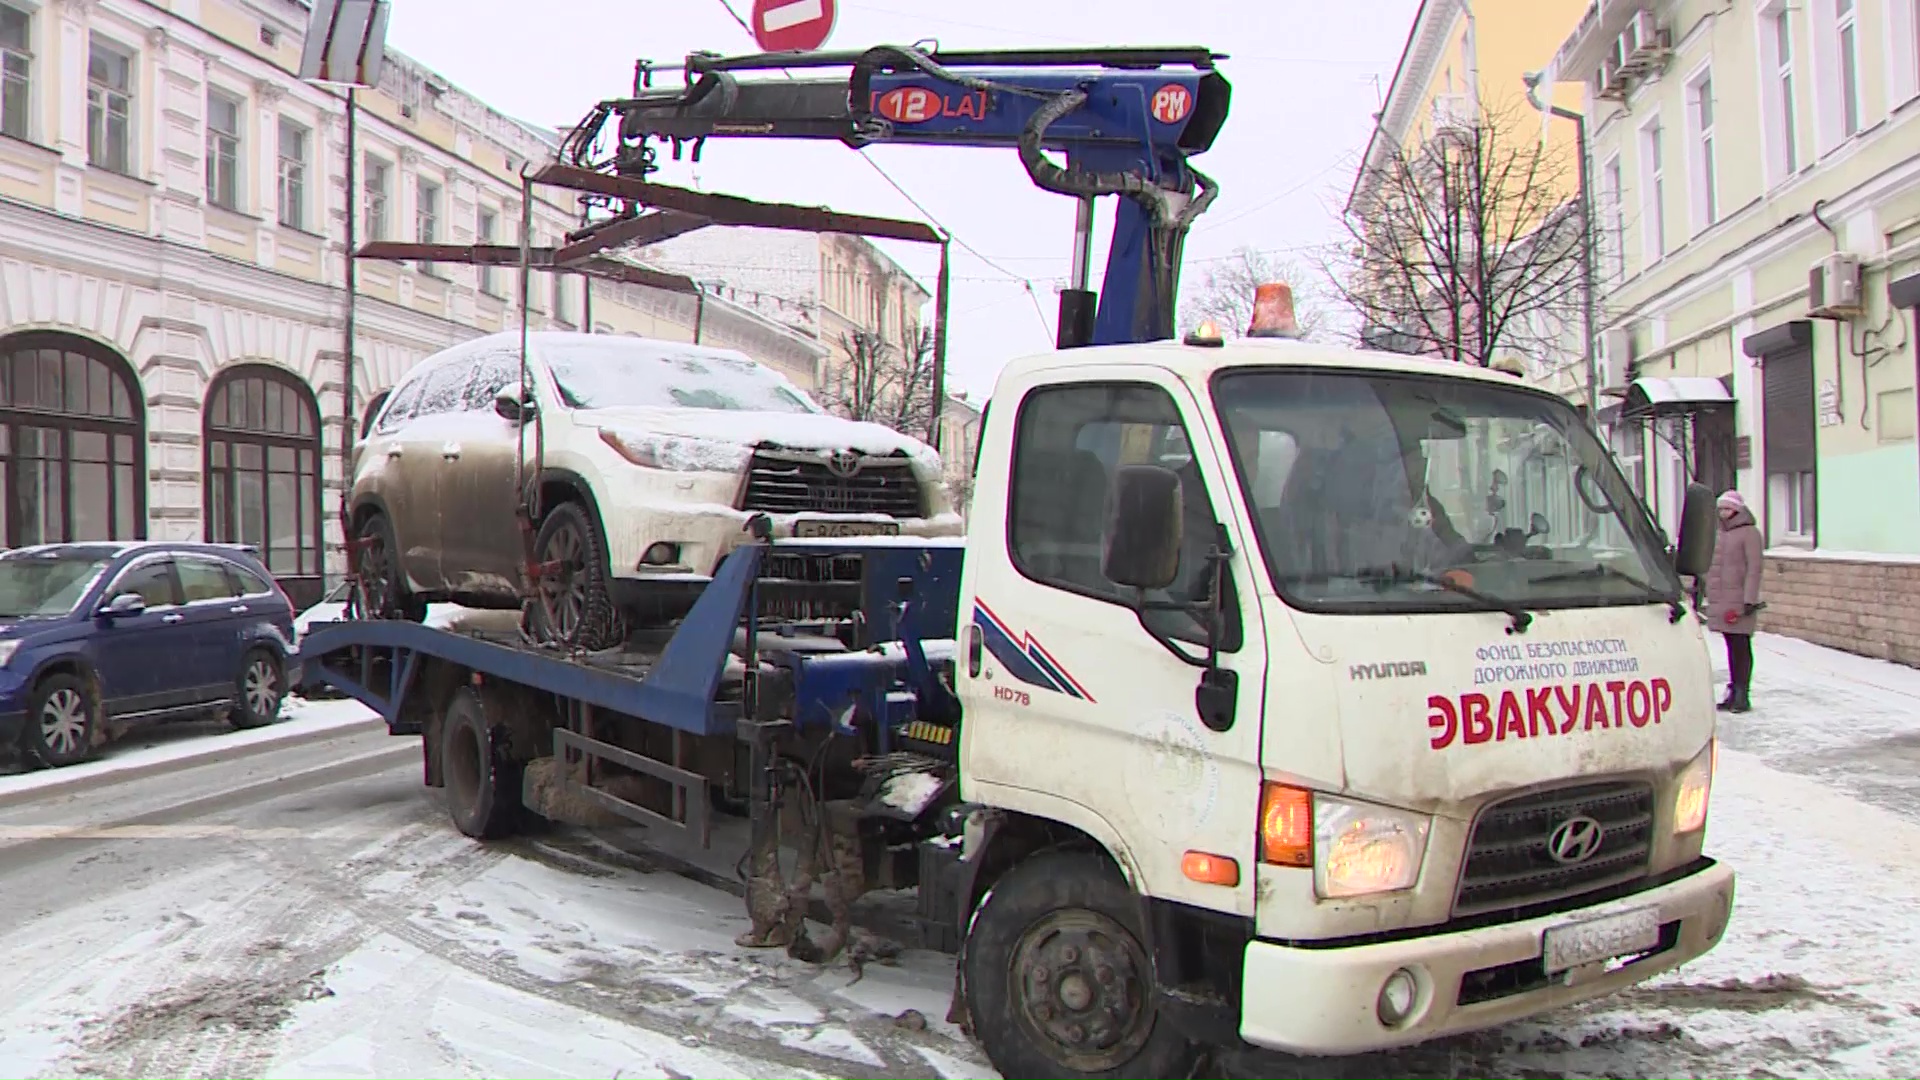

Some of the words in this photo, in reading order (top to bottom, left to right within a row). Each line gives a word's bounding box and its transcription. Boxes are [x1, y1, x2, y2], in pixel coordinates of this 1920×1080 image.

[1475, 644, 1523, 661] ФОНД
[1526, 639, 1627, 659] БЕЗОПАСНОСТИ
[1350, 660, 1427, 680] HYUNDAI
[1474, 659, 1567, 685] ДОРОЖНОГО
[1572, 657, 1640, 678] ДВИЖЕНИЯ
[993, 684, 1031, 707] HD78
[1427, 677, 1672, 751] ЭВАКУАТОР
